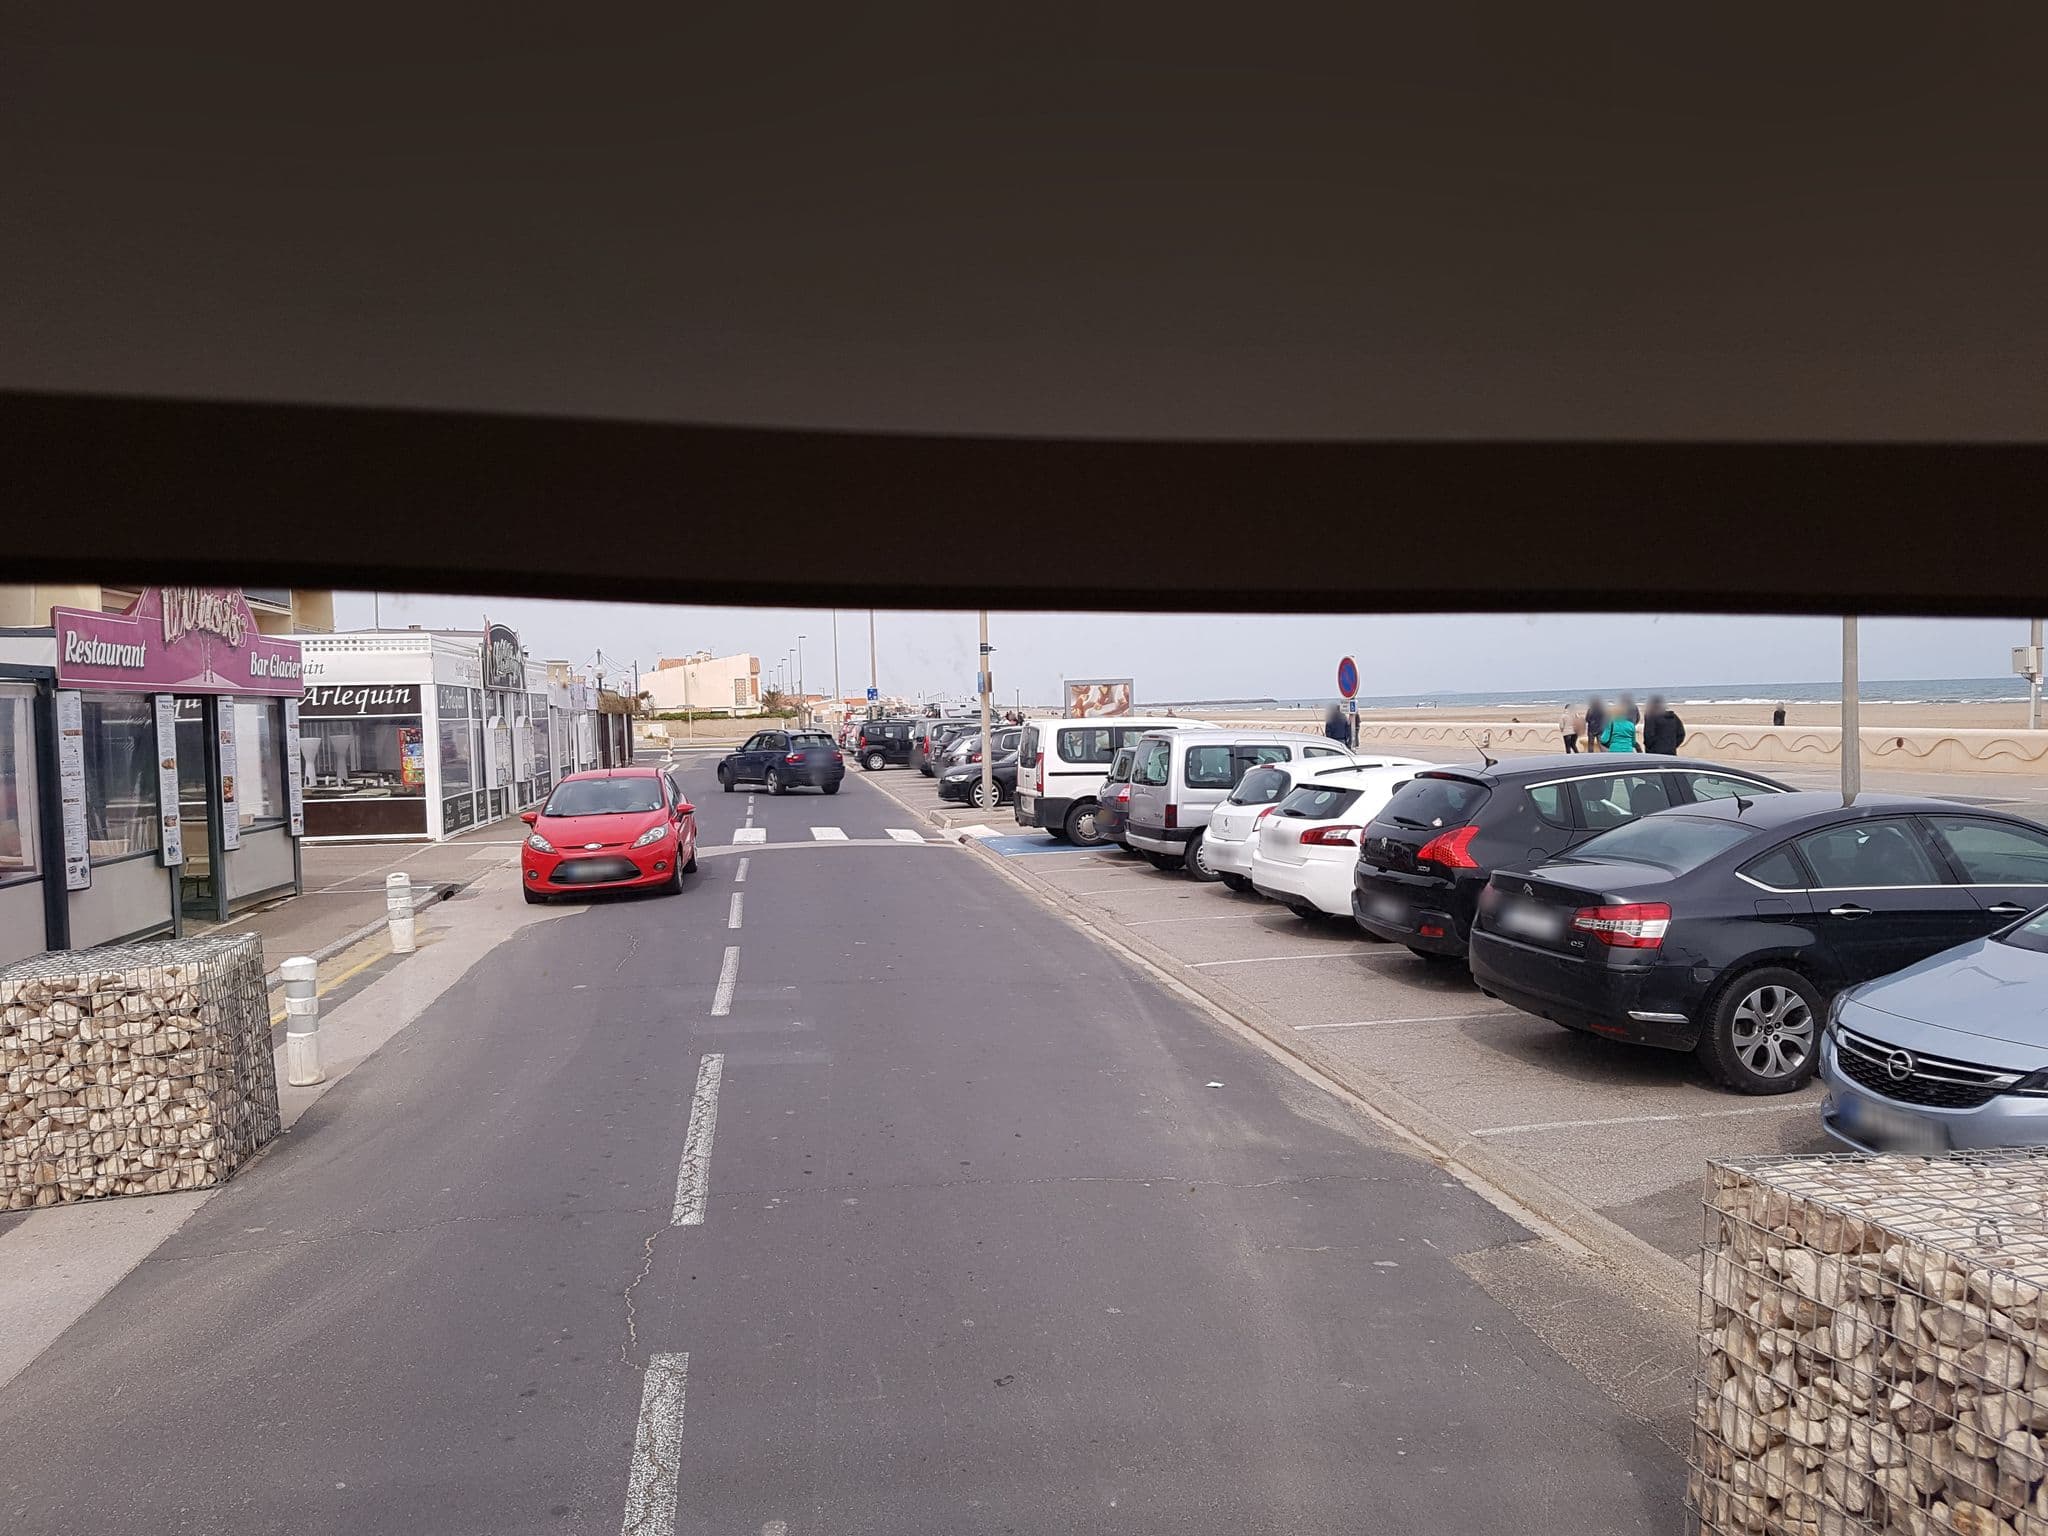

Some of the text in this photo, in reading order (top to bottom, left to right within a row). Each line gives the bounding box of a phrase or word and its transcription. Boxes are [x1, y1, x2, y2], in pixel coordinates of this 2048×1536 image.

[65, 630, 146, 668] Restaurant
[250, 651, 301, 679] Bar Glacier
[299, 684, 412, 714] Arlequin
